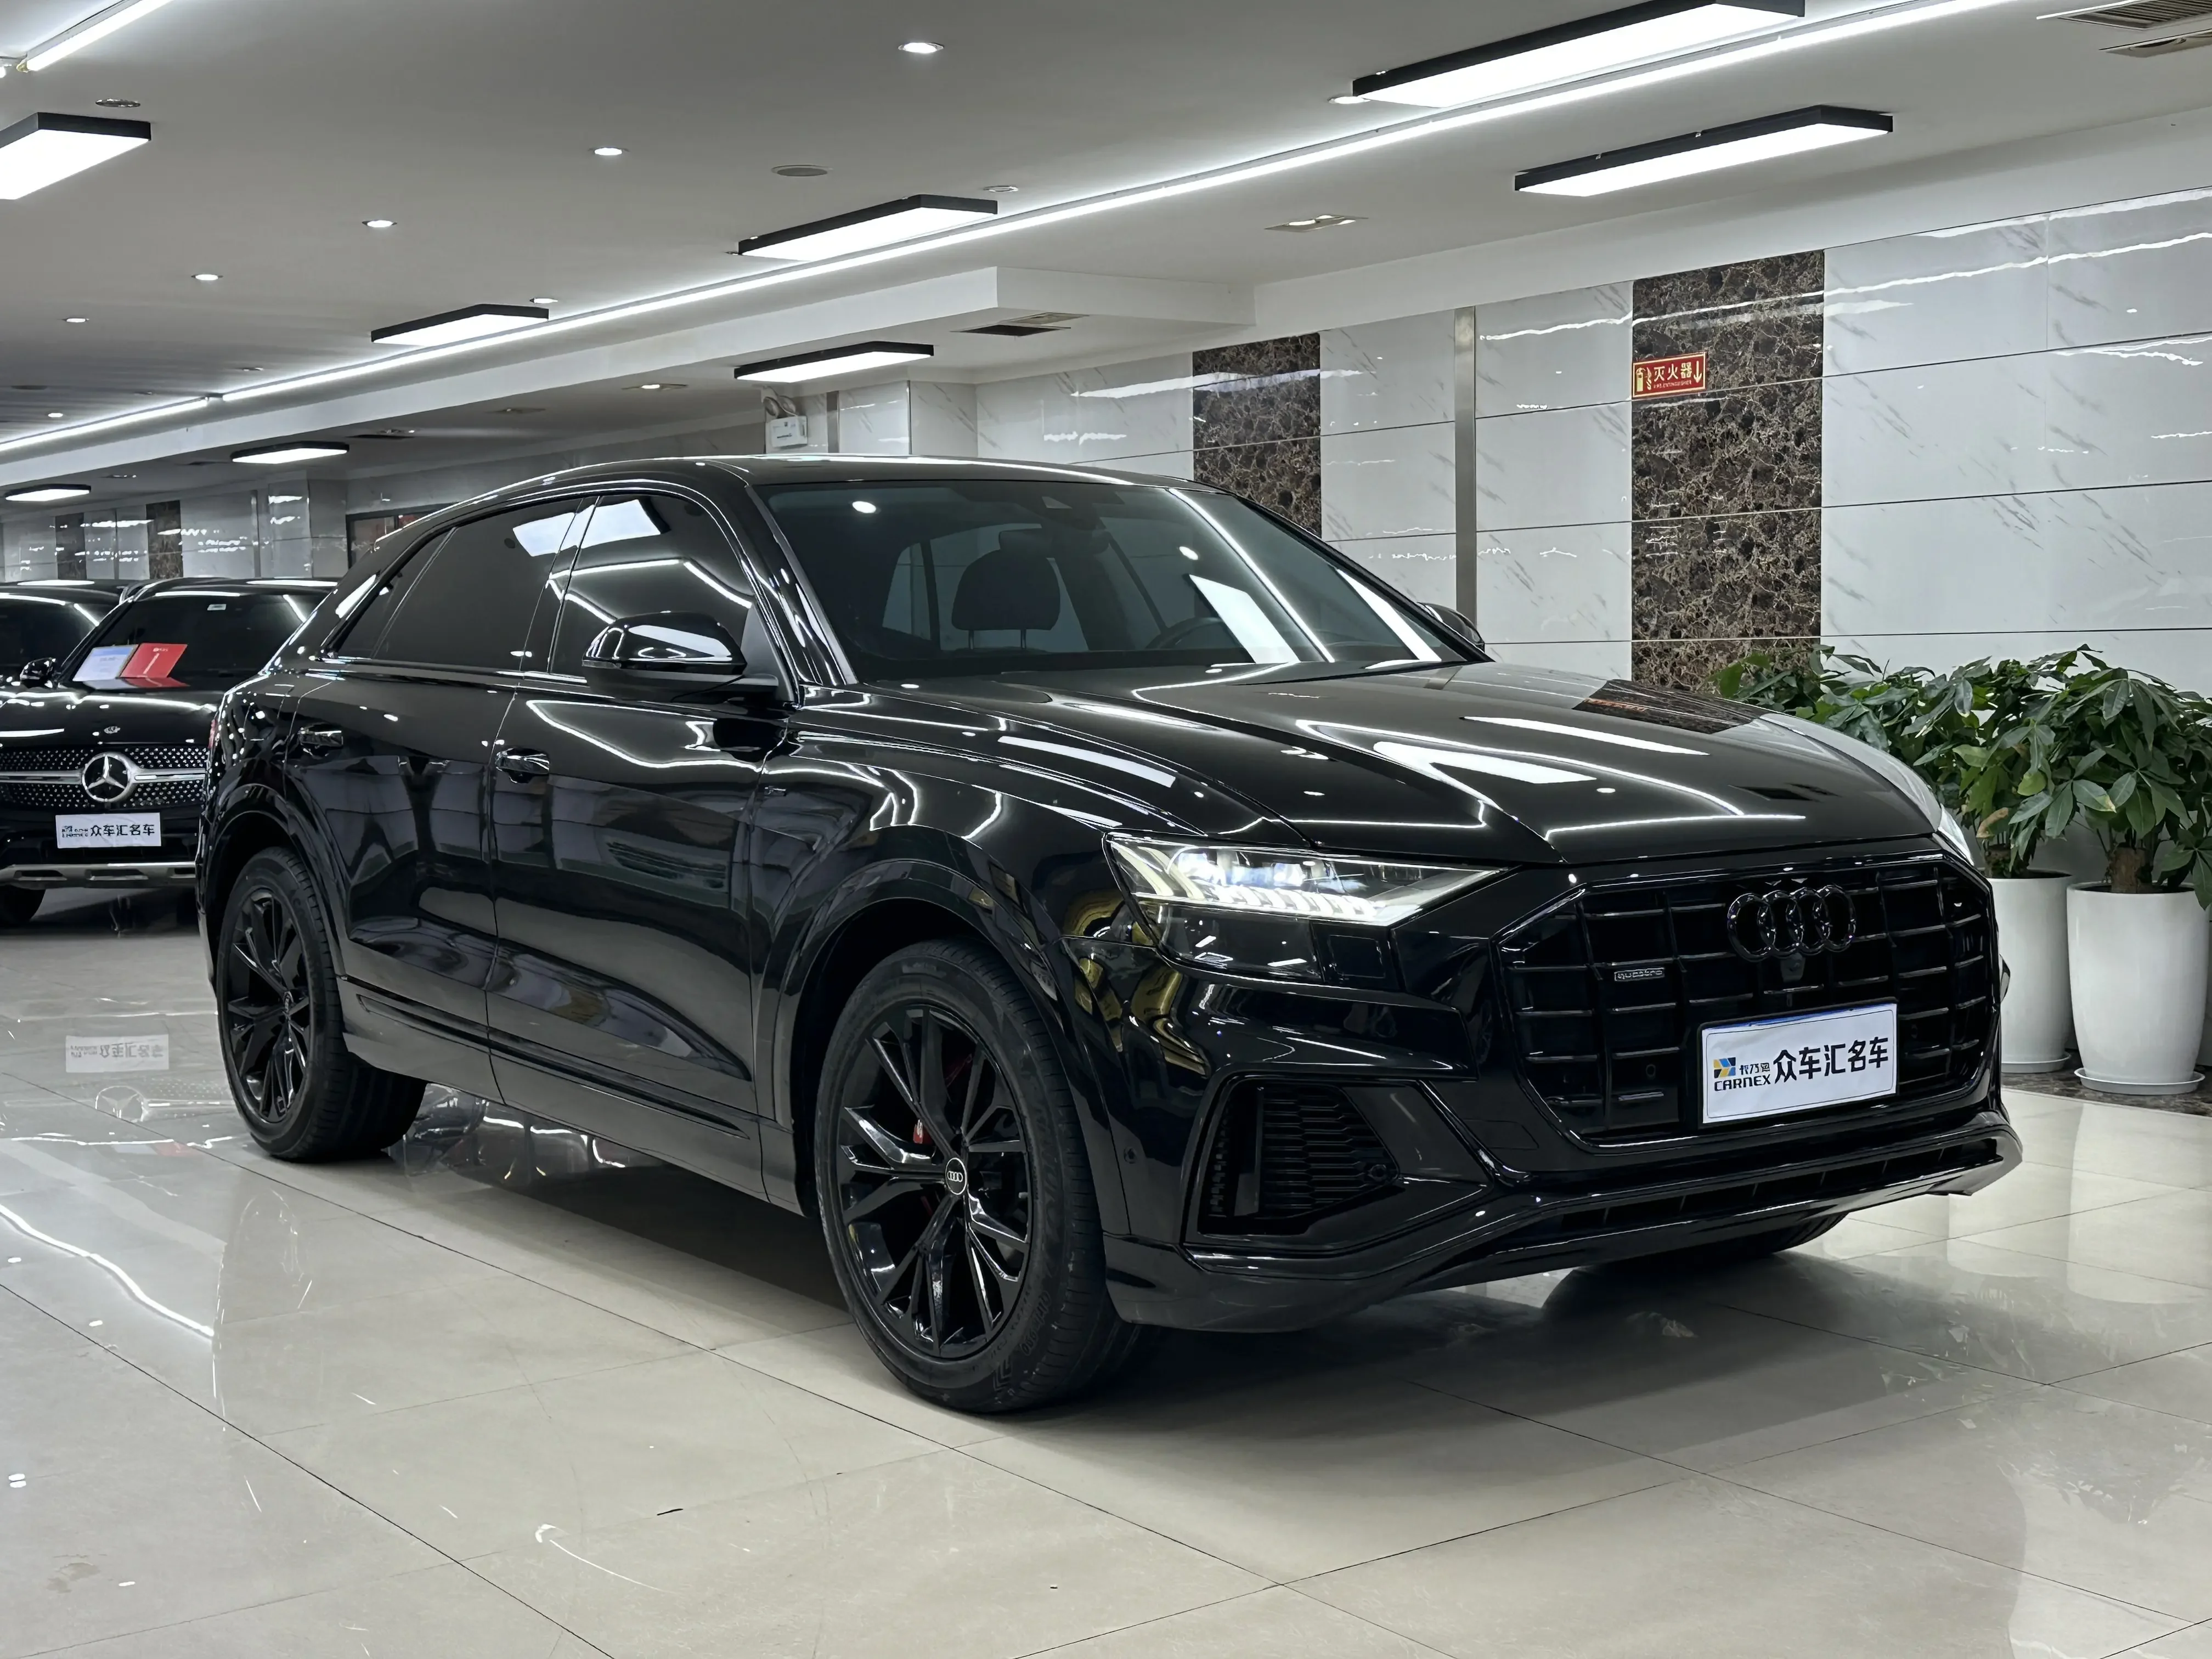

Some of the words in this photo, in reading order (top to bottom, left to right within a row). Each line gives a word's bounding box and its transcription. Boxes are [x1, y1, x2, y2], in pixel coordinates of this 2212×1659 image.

[1654, 362, 1692, 382] 灭火器
[90, 824, 155, 837] 众车汇名车
[1773, 1036, 1888, 1084] 众车汇名车
[1714, 1074, 1771, 1091] CARNEX
